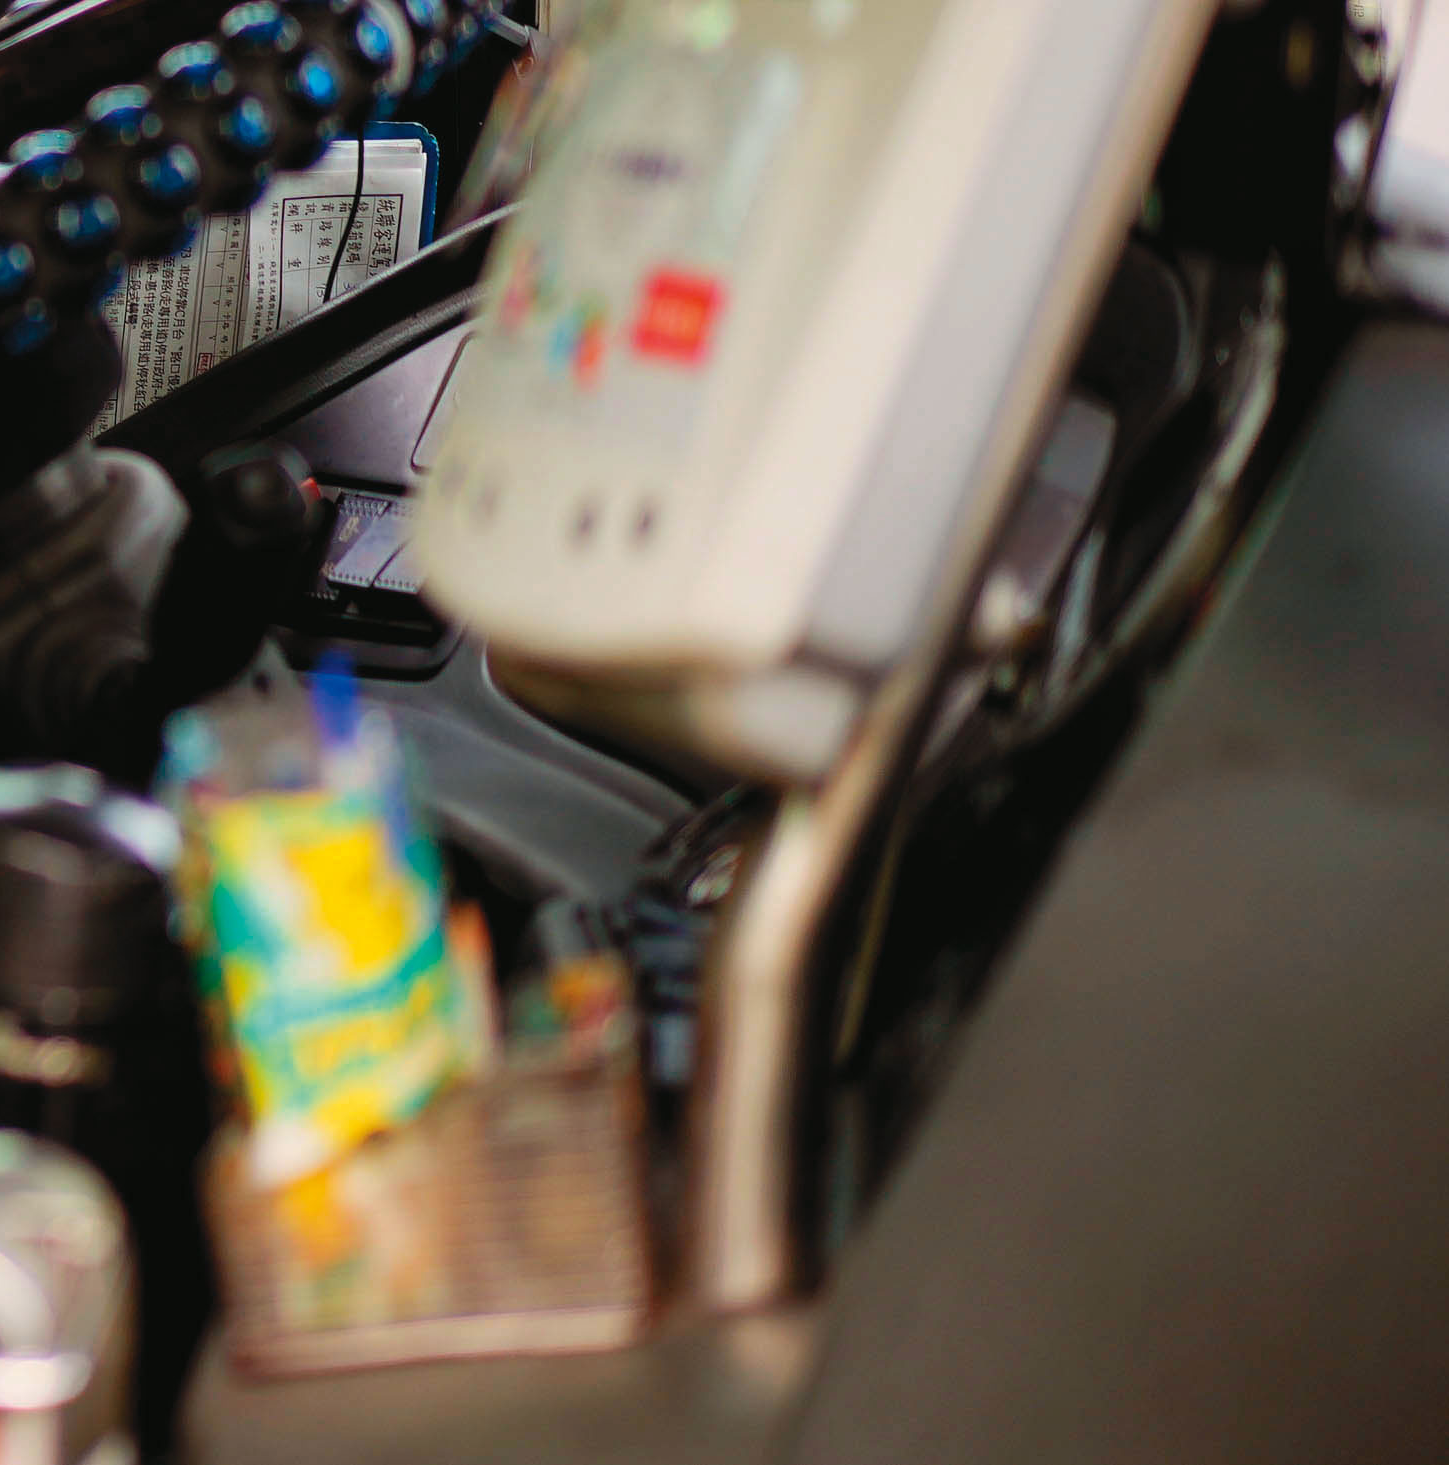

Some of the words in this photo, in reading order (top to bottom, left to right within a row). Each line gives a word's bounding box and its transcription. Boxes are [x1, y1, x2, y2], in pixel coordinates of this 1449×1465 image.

[369, 199, 396, 278] 統聯客運駕
